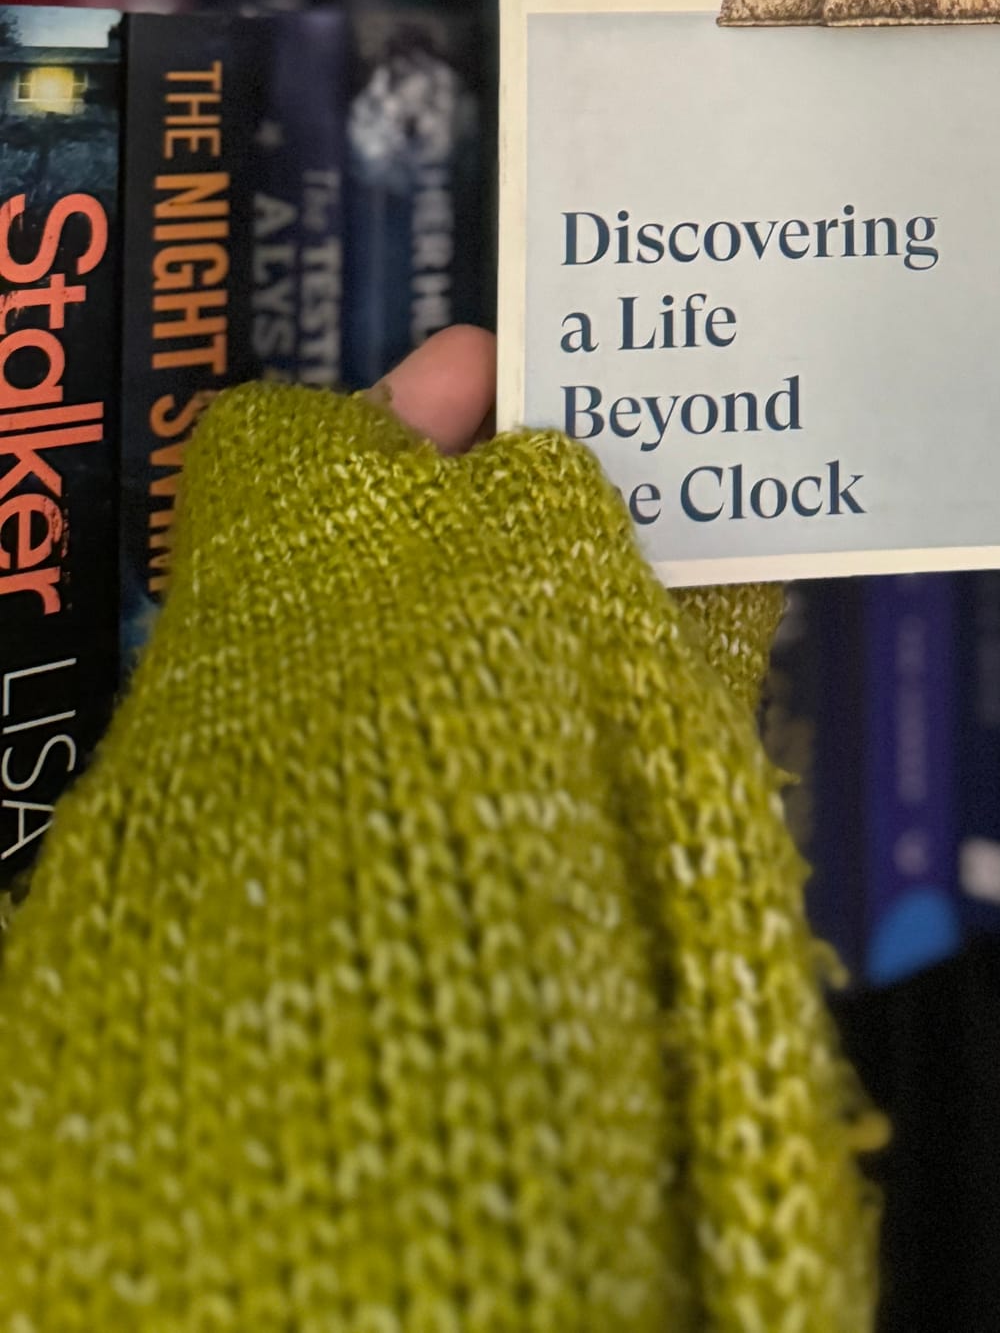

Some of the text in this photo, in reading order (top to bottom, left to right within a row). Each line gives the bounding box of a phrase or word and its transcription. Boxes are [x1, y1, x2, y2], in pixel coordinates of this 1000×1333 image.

[164, 60, 222, 158] THE
[152, 172, 230, 375] NIGHT
[561, 204, 939, 271] Discovering
[560, 293, 737, 353] a Life
[561, 375, 803, 452] Beyond
[0, 192, 108, 861] Stalker LISA
[680, 460, 867, 523] Clock
